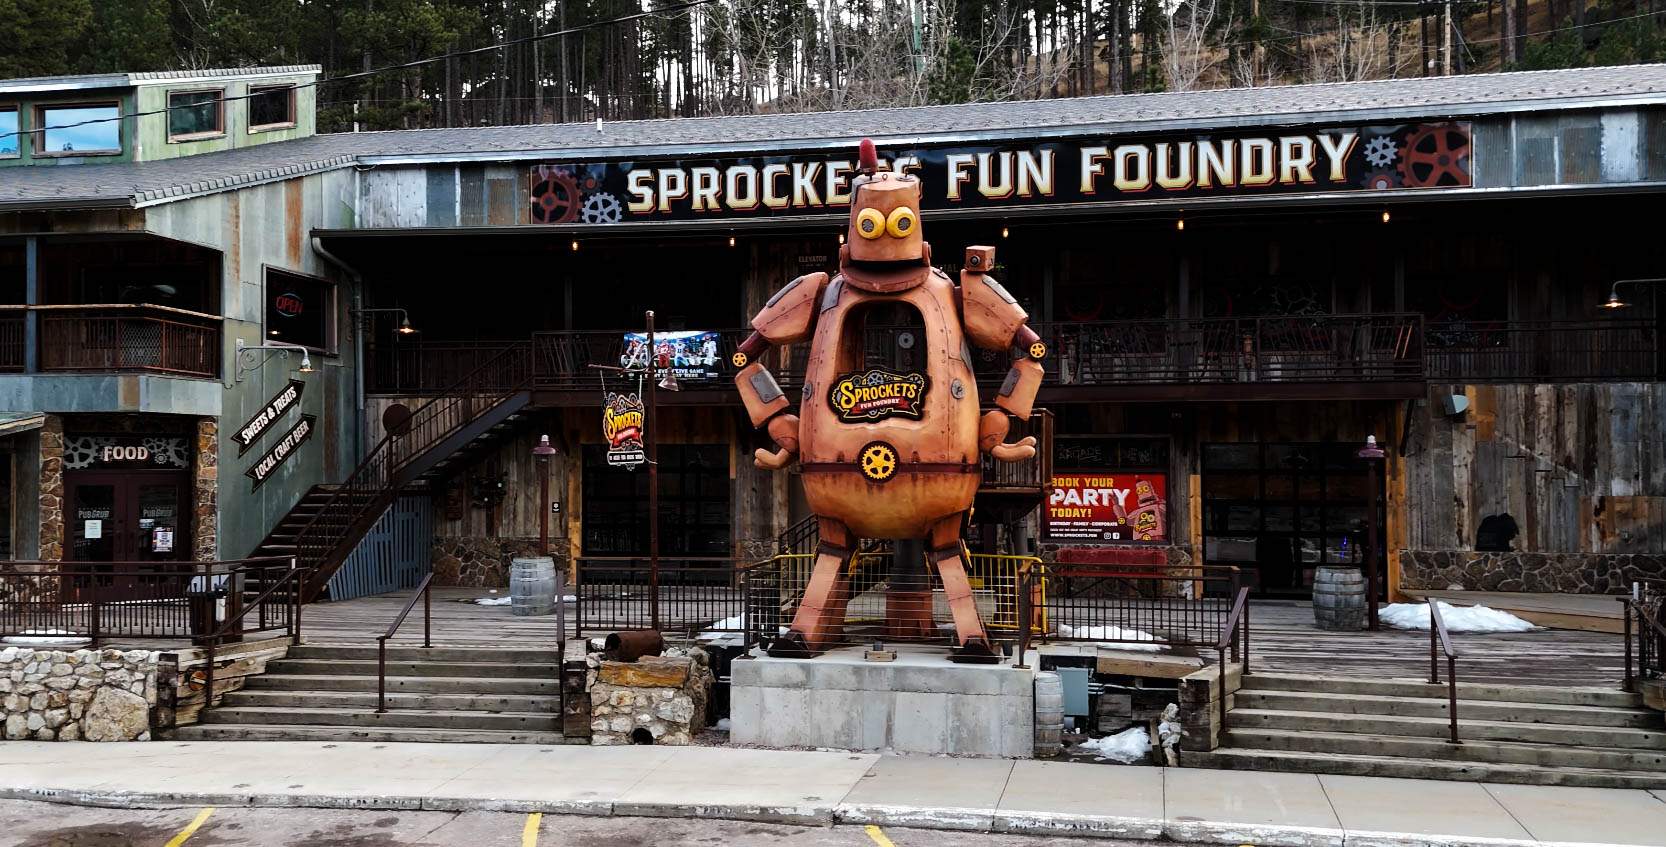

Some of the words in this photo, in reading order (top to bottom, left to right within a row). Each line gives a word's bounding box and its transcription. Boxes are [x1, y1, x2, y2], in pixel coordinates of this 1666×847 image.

[946, 148, 1055, 201] FUN
[1080, 132, 1360, 194] FOUNDRY
[798, 255, 828, 264] ELEVATOR
[275, 296, 303, 314] OPEN
[840, 381, 917, 409] SPROCKETS
[860, 401, 872, 409] FUN
[873, 398, 900, 407] FOUNDRY
[241, 412, 269, 444] SWEETS
[267, 407, 275, 420] &
[273, 386, 297, 415] TREATS
[103, 446, 149, 462] FOOD
[254, 454, 277, 480] LOCAL
[274, 434, 294, 460] CRAFT
[293, 420, 310, 443] BEER
[1084, 477, 1114, 487] YOUR
[1050, 488, 1130, 506] PARTY
[78, 510, 92, 518] PUB
[92, 510, 110, 518] GRUB
[1050, 508, 1092, 518] TODAY!
